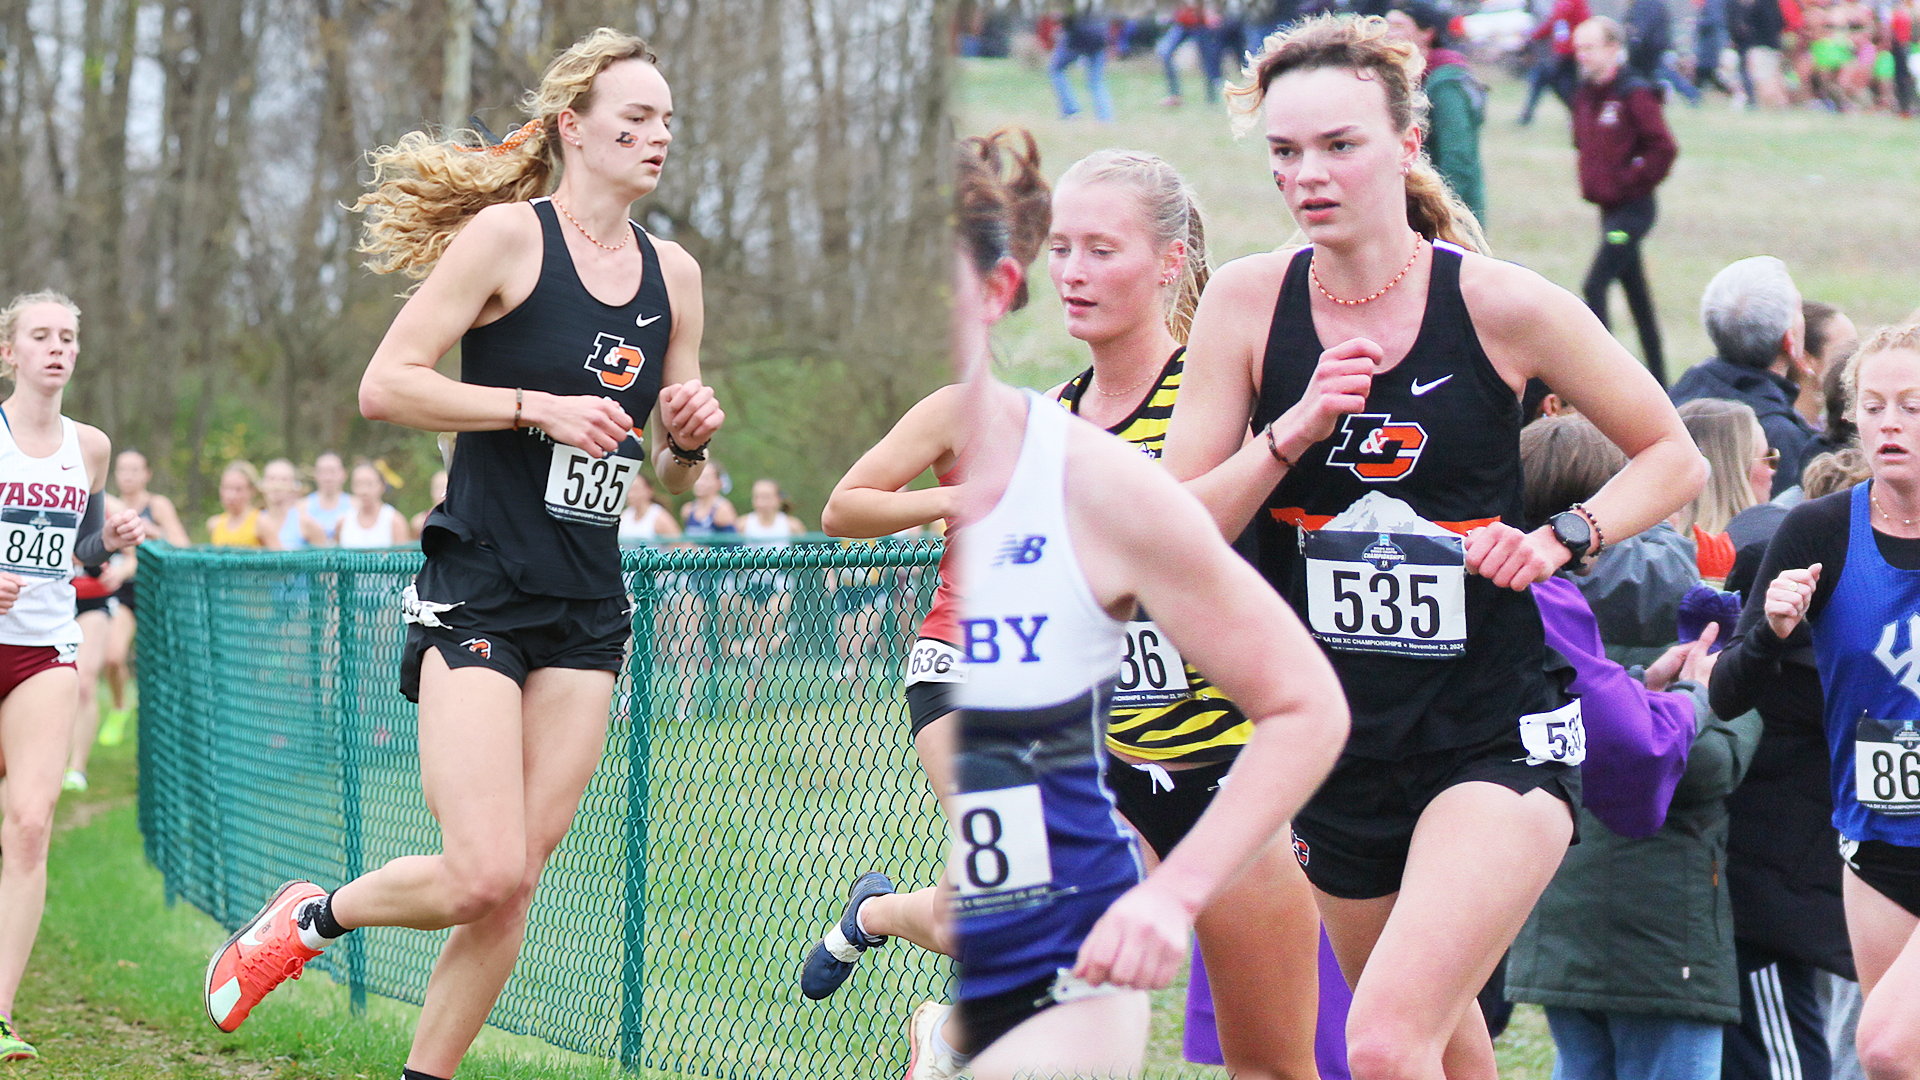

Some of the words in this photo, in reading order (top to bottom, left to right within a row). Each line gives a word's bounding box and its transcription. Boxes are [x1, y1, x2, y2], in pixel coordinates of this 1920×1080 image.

[563, 454, 630, 513] 535
[5, 529, 65, 568] 848
[1332, 569, 1441, 639] 535
[911, 646, 955, 675] 636
[1352, 639, 1402, 648] CHAMPIONSHIPS
[1408, 643, 1439, 651] November
